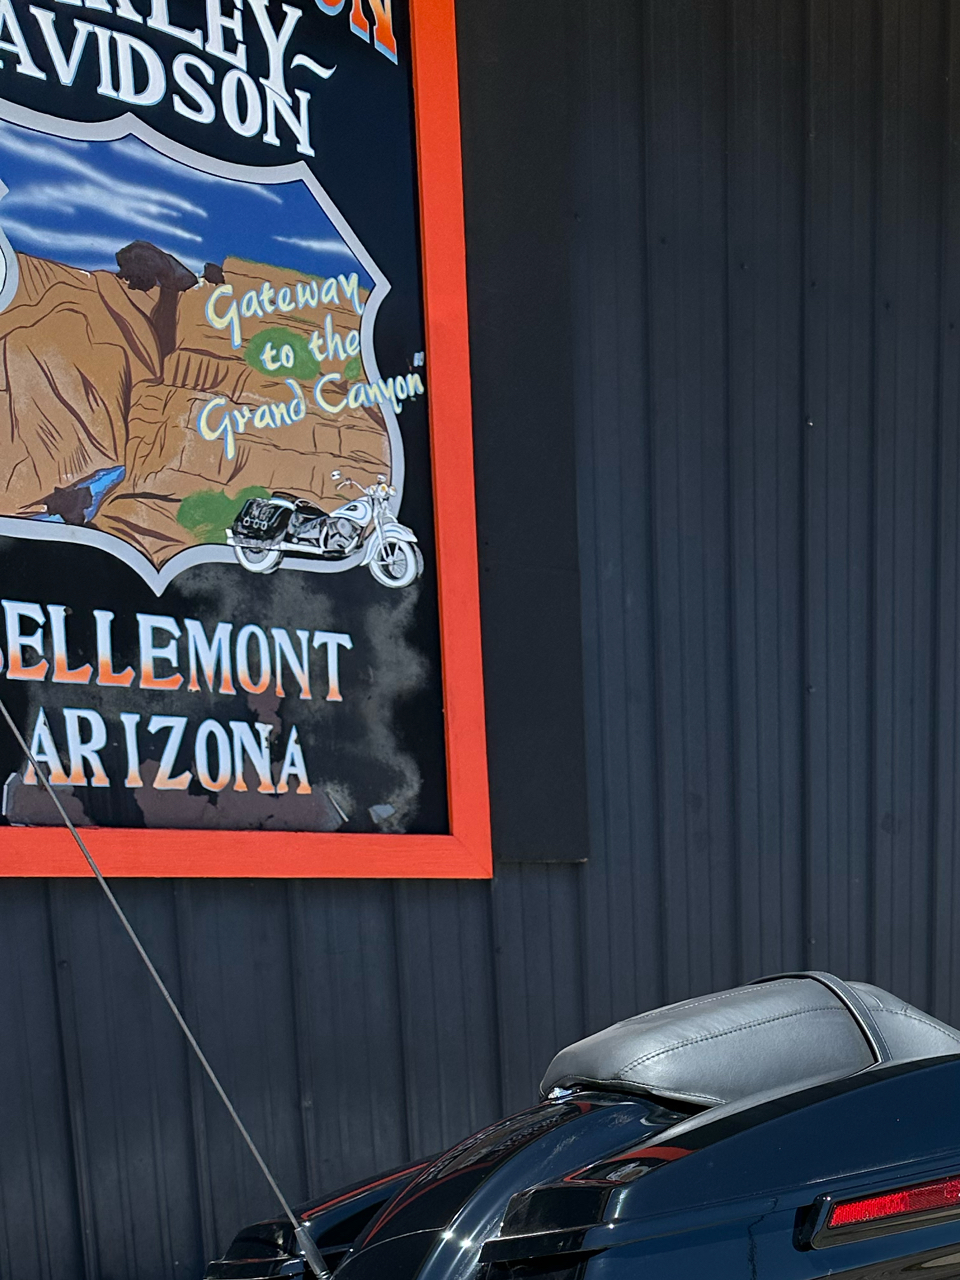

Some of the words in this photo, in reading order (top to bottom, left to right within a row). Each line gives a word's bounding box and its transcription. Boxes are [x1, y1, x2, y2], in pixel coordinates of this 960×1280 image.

[0, 0, 315, 157] AVIDSON
[205, 272, 364, 348] Gateway
[261, 342, 294, 371] to
[308, 314, 360, 361] the
[196, 379, 306, 460] Grand
[0, 599, 353, 702] ELLEMONT
[23, 707, 312, 794] ARIZONA
